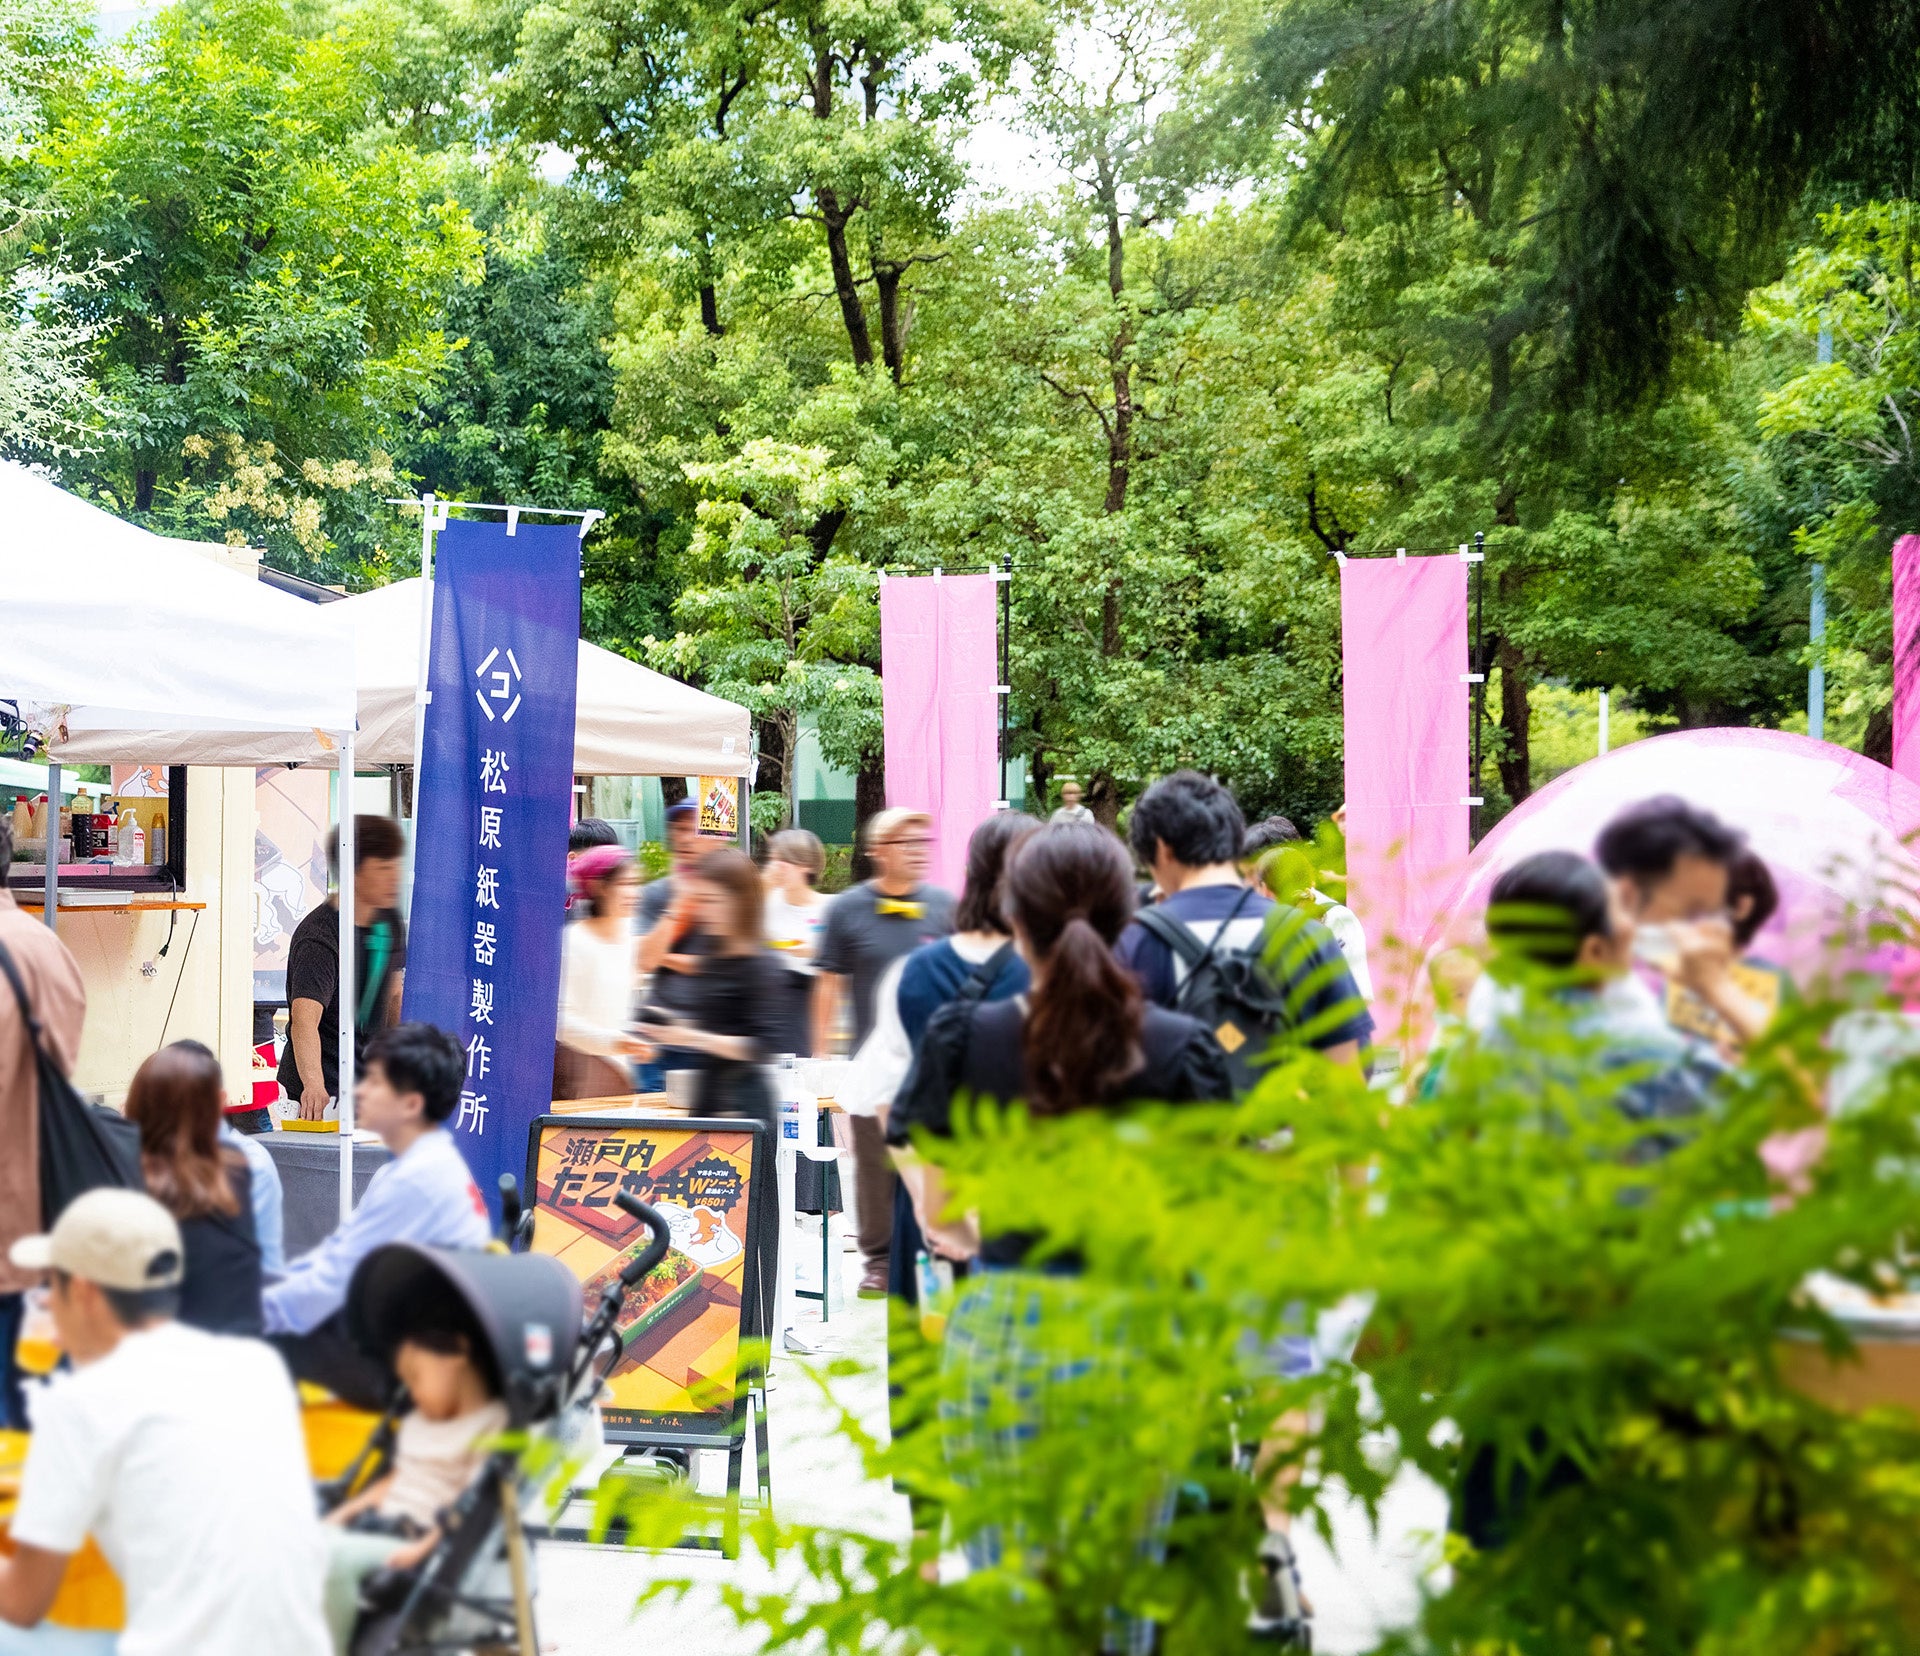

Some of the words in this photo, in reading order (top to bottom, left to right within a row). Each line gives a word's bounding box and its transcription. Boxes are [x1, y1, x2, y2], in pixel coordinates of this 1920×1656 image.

[455, 748, 510, 1136] 松原紙器製作所
[560, 1137, 657, 1168] 瀬戸内
